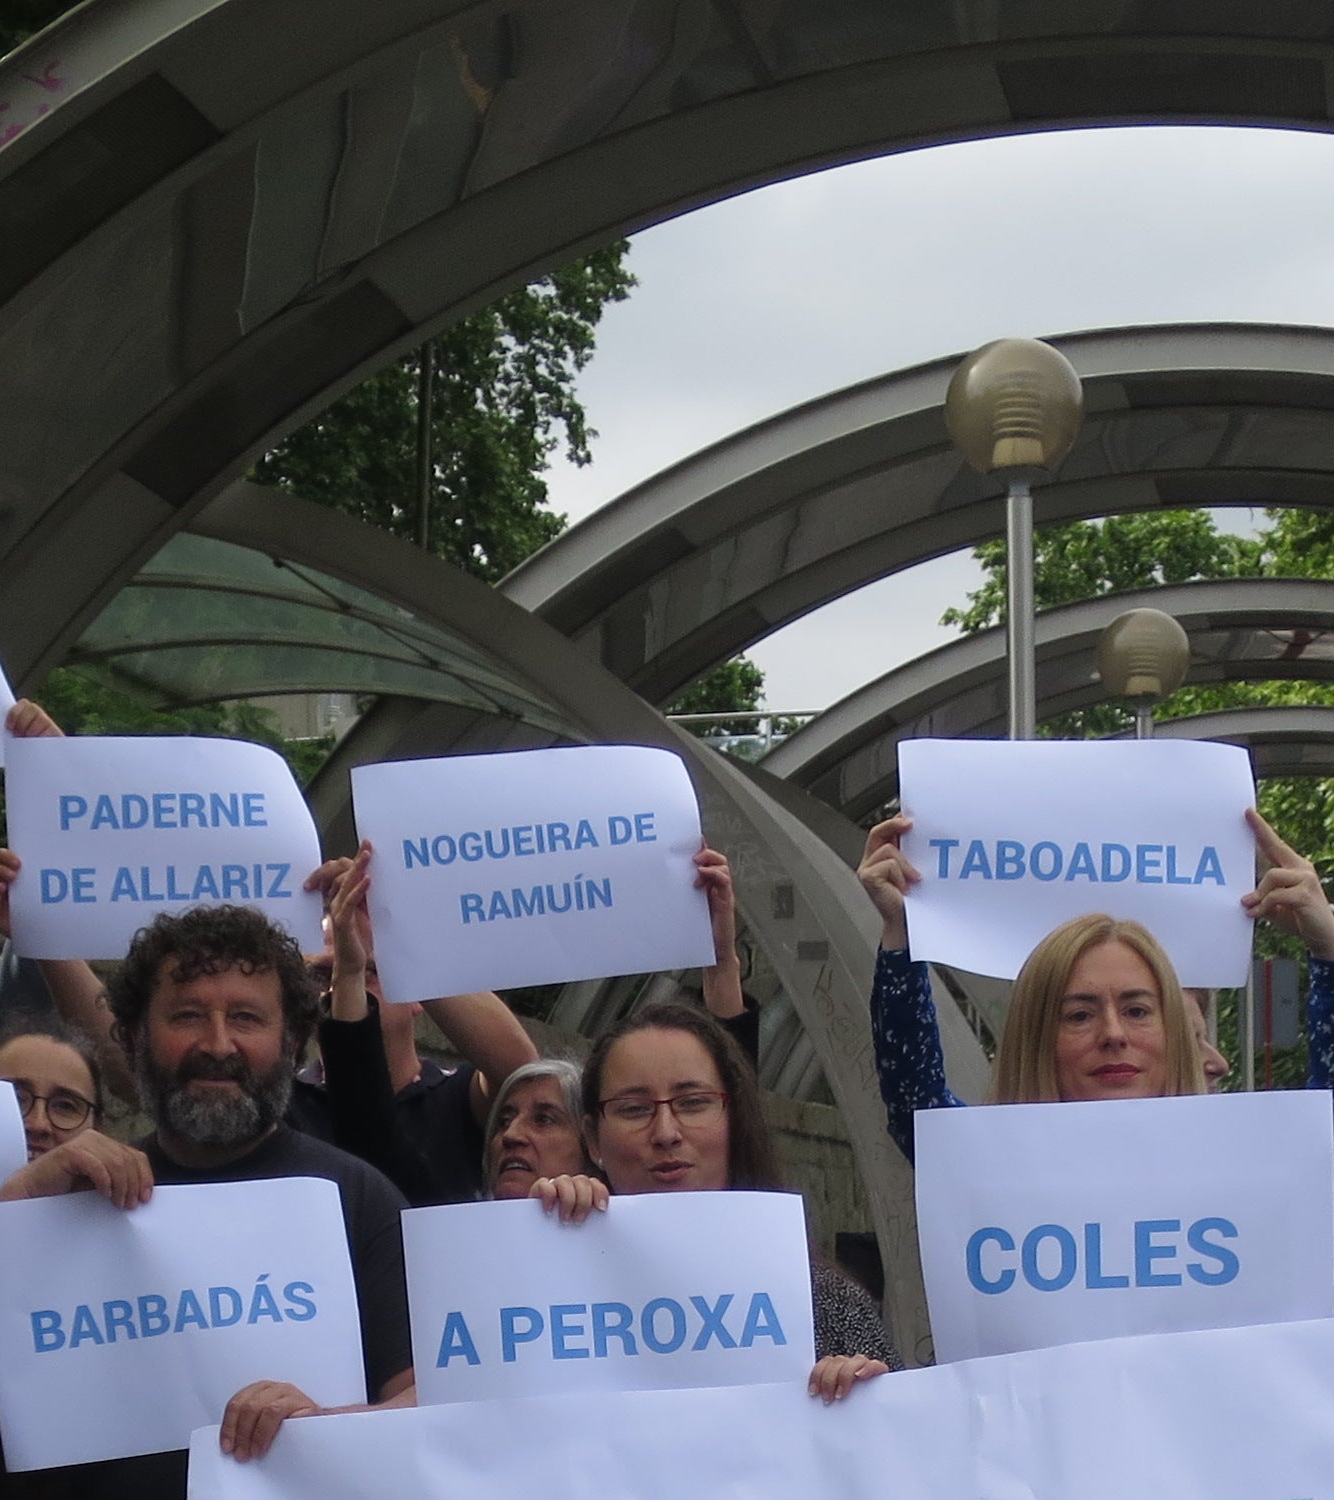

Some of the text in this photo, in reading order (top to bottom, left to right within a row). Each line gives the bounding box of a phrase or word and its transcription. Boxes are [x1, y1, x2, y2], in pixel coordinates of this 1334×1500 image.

[60, 792, 268, 831] PADERNE
[403, 812, 657, 869] NOGUEIRA DE
[930, 838, 1227, 886] TABOADELA
[40, 863, 292, 904] DE ALLARIZ
[460, 874, 615, 924] RAMUÍN
[966, 1216, 1241, 1295] COLES
[30, 1273, 318, 1354] BARBADÁS
[436, 1291, 787, 1369] A PEROXA
